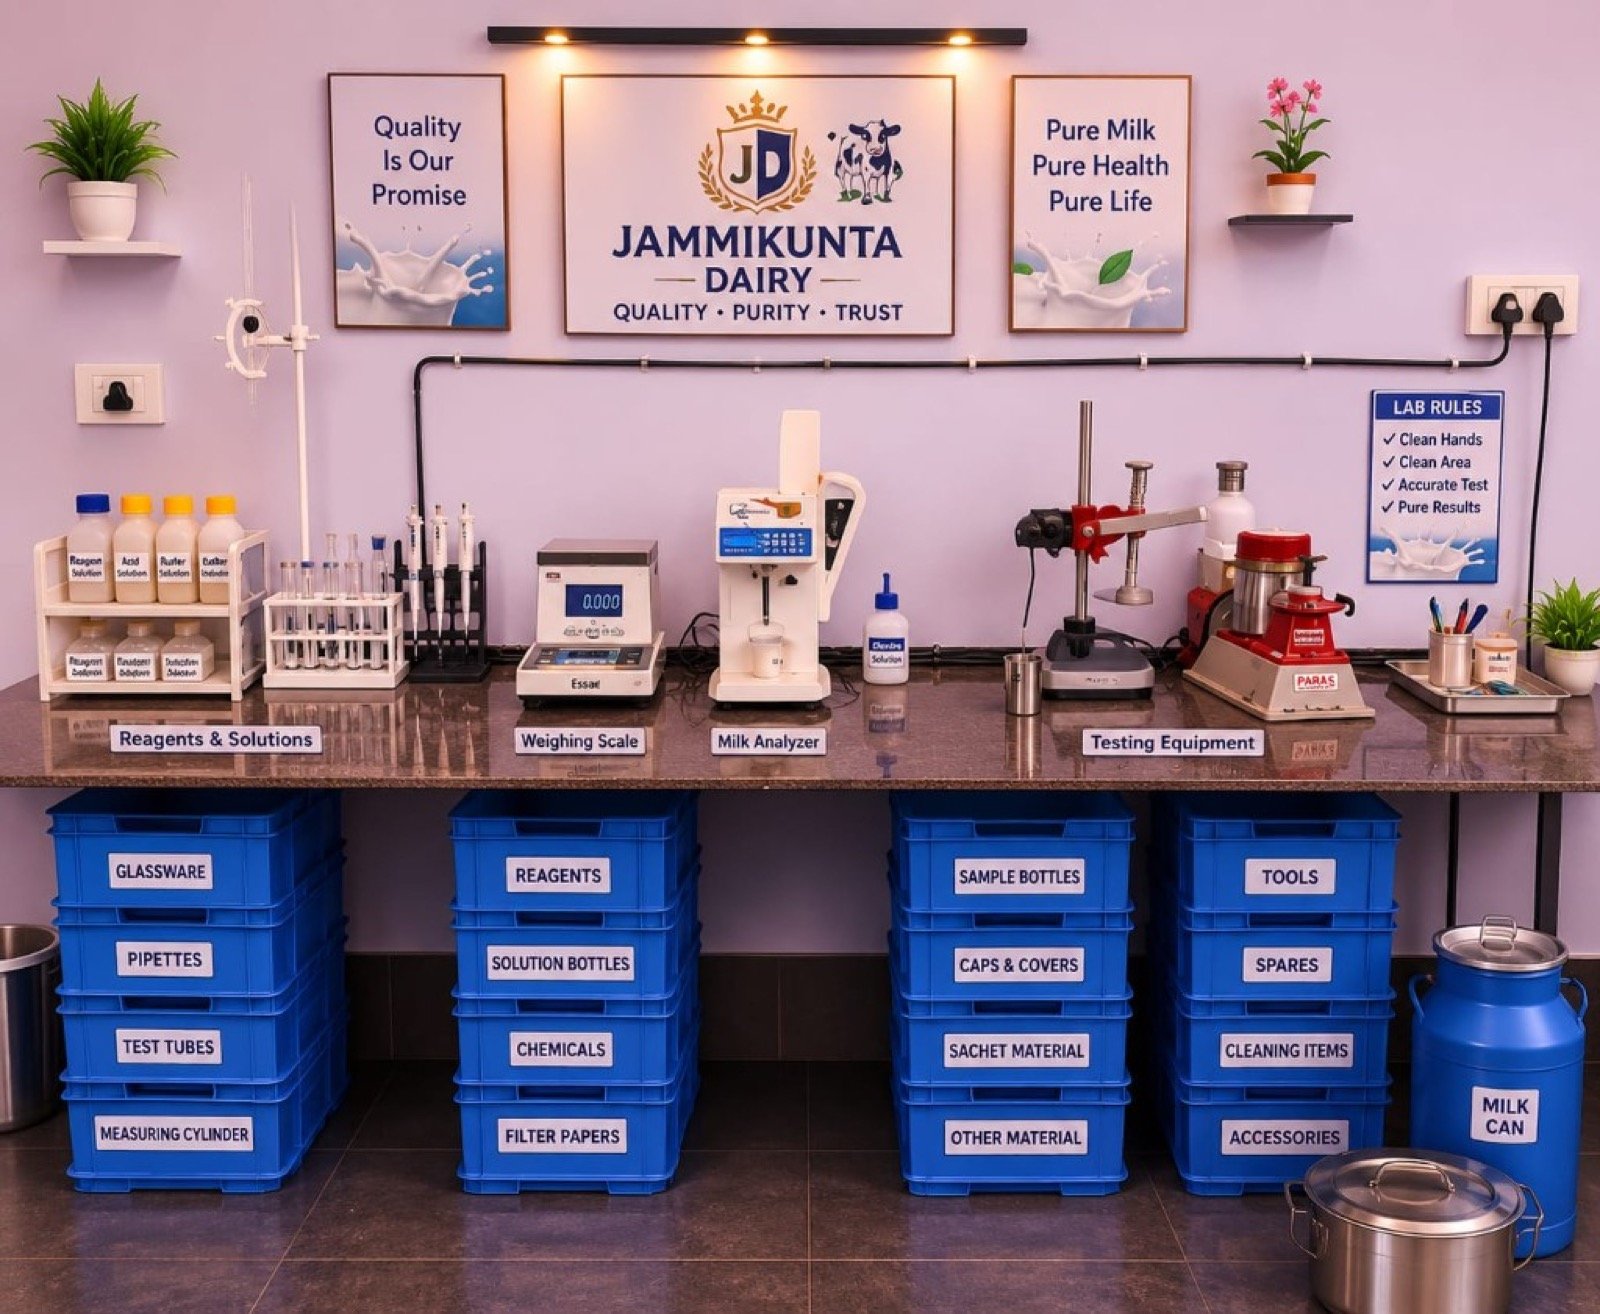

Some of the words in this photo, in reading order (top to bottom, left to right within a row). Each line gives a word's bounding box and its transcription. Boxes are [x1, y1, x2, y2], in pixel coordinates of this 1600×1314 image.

[375, 115, 461, 142] Quality
[1048, 119, 1099, 141] Pure
[1108, 119, 1155, 140] Milk
[384, 150, 402, 170] Is
[409, 150, 453, 171] Our
[1034, 155, 1086, 176] Pure
[1094, 154, 1168, 175] Health
[373, 184, 466, 205] Promise
[1050, 190, 1102, 211] Pure
[1111, 190, 1152, 211] Life
[612, 225, 902, 258] JAMMIKUNTA
[706, 267, 812, 293] DAIRY
[614, 303, 708, 322] QUALITY
[734, 304, 809, 320] PURITY
[835, 305, 903, 320] TRUST
[1394, 400, 1425, 414] LAB
[1431, 400, 1481, 414] RULES
[1400, 433, 1436, 446] Clean
[1441, 433, 1482, 446] Hands
[1400, 455, 1436, 468] Clean
[1441, 456, 1470, 469] Area
[1398, 478, 1458, 491] Accurate
[1461, 478, 1488, 491] Test
[1399, 500, 1428, 513] Pure
[1433, 501, 1480, 513] Results
[583, 593, 621, 611] 0.000
[1297, 676, 1335, 687] PARAS
[119, 731, 203, 749] Reagents
[210, 731, 222, 746] &
[229, 731, 312, 747] Solutions
[522, 733, 592, 751] Weighing
[598, 734, 638, 748] Scale
[718, 734, 749, 748] Milk
[754, 734, 819, 752] Analyzer
[1092, 735, 1154, 753] Testing
[1161, 735, 1255, 753] Equipment
[116, 864, 205, 878] GLASSWARE
[516, 868, 601, 883] REAGENTS
[960, 870, 1015, 884] SAMPLE
[1020, 870, 1080, 884] BOTTLES
[1262, 870, 1318, 884] TOOLS
[128, 952, 202, 967] PIPETTES
[492, 956, 563, 970] SOLUTION
[568, 956, 630, 970] BOTTLES
[959, 958, 999, 972] CAPS
[1004, 958, 1014, 972] &
[1019, 958, 1078, 972] COVERS
[1256, 958, 1318, 972] SPARES
[123, 1039, 160, 1054] TEST
[164, 1040, 214, 1055] TUBES
[517, 1042, 605, 1057] CHEMICALS
[950, 1044, 1007, 1058] SACHET
[1012, 1044, 1084, 1058] MATERIAL
[1225, 1044, 1300, 1058] CLEANING
[1305, 1044, 1348, 1058] ITEMS
[1483, 1097, 1528, 1114] MILK
[101, 1126, 180, 1141] MEASURING
[183, 1128, 248, 1141] CYLINDER
[1486, 1119, 1523, 1135] CAN
[506, 1129, 556, 1143] FILTER
[561, 1130, 619, 1144] PAPERS
[951, 1131, 1001, 1145] OTHER
[1007, 1131, 1081, 1144] MATERIAL
[1230, 1130, 1341, 1145] ACCESSORIES
